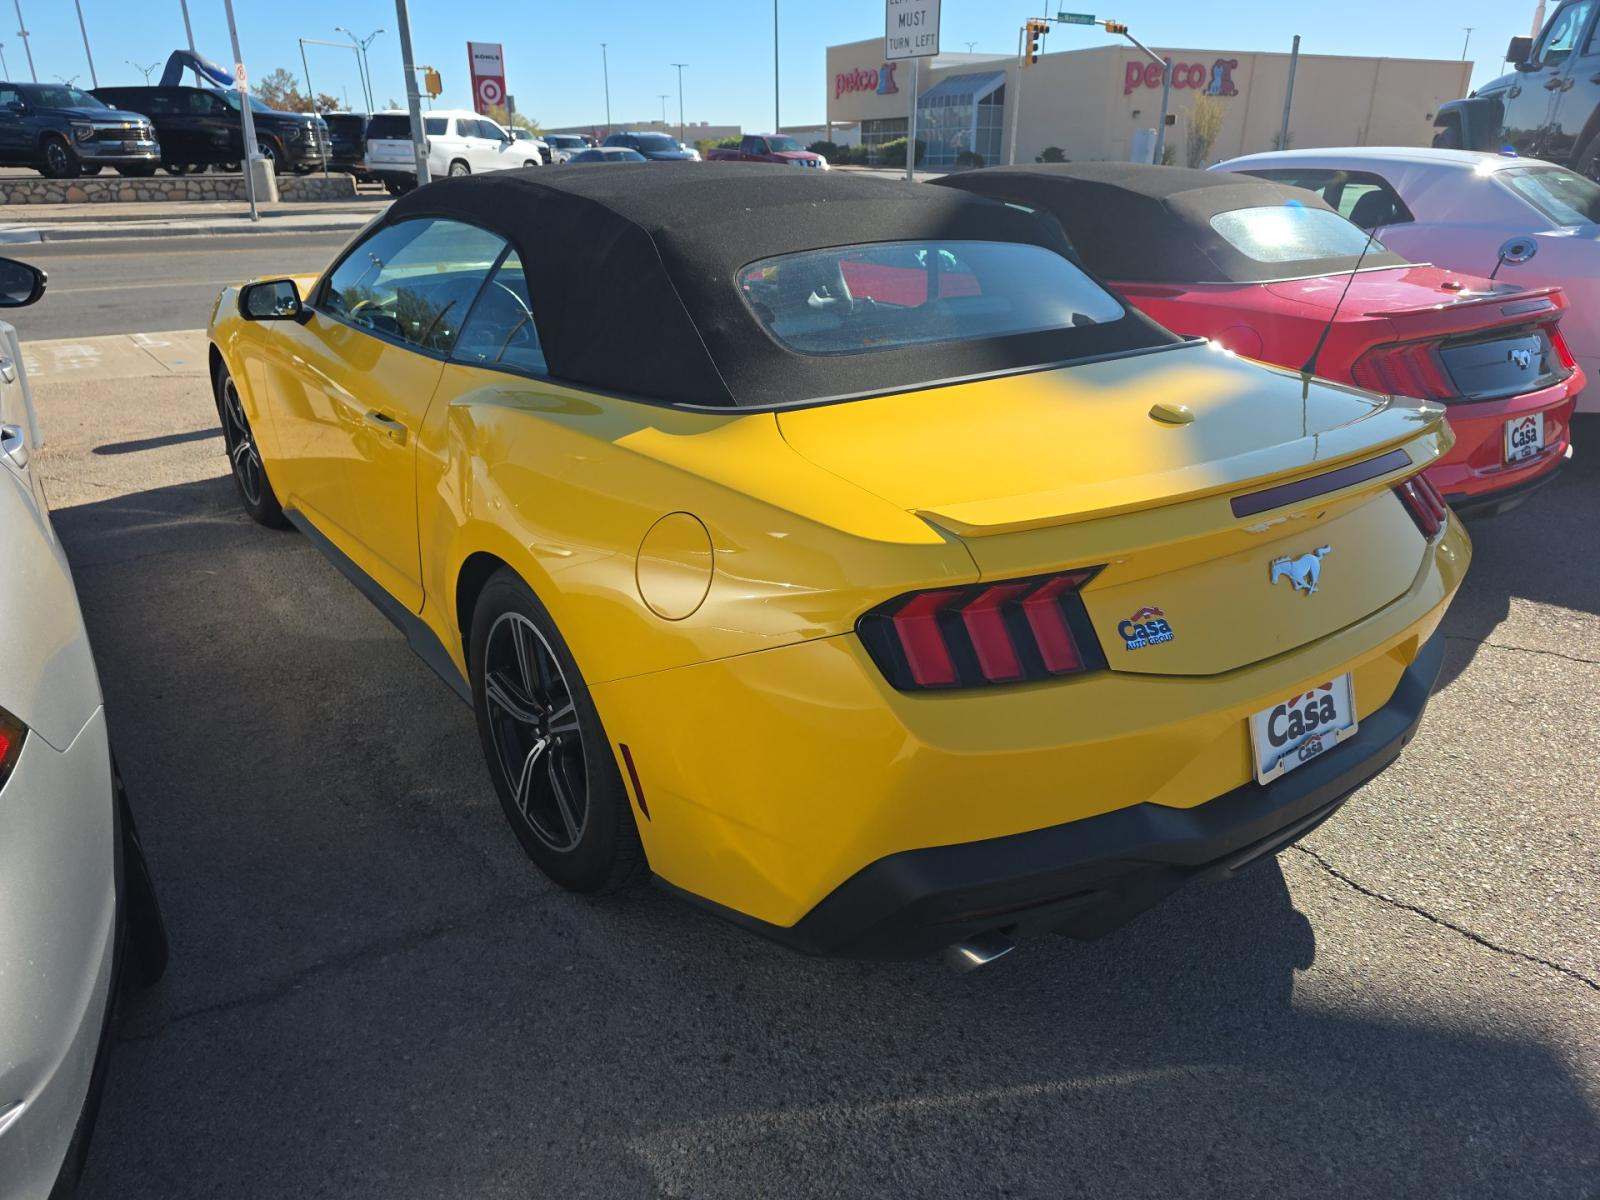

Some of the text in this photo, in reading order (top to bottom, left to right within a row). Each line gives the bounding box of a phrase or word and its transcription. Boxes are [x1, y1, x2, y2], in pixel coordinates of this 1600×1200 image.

[898, 10, 927, 28] MUST
[889, 34, 935, 50] TURN LEFT
[835, 68, 879, 99] petco
[1511, 427, 1537, 448] Casa
[1118, 619, 1172, 641] Casa
[1127, 633, 1174, 650] AUTO GROUP
[1268, 694, 1337, 748] Casa
[1298, 741, 1323, 761] Casa
